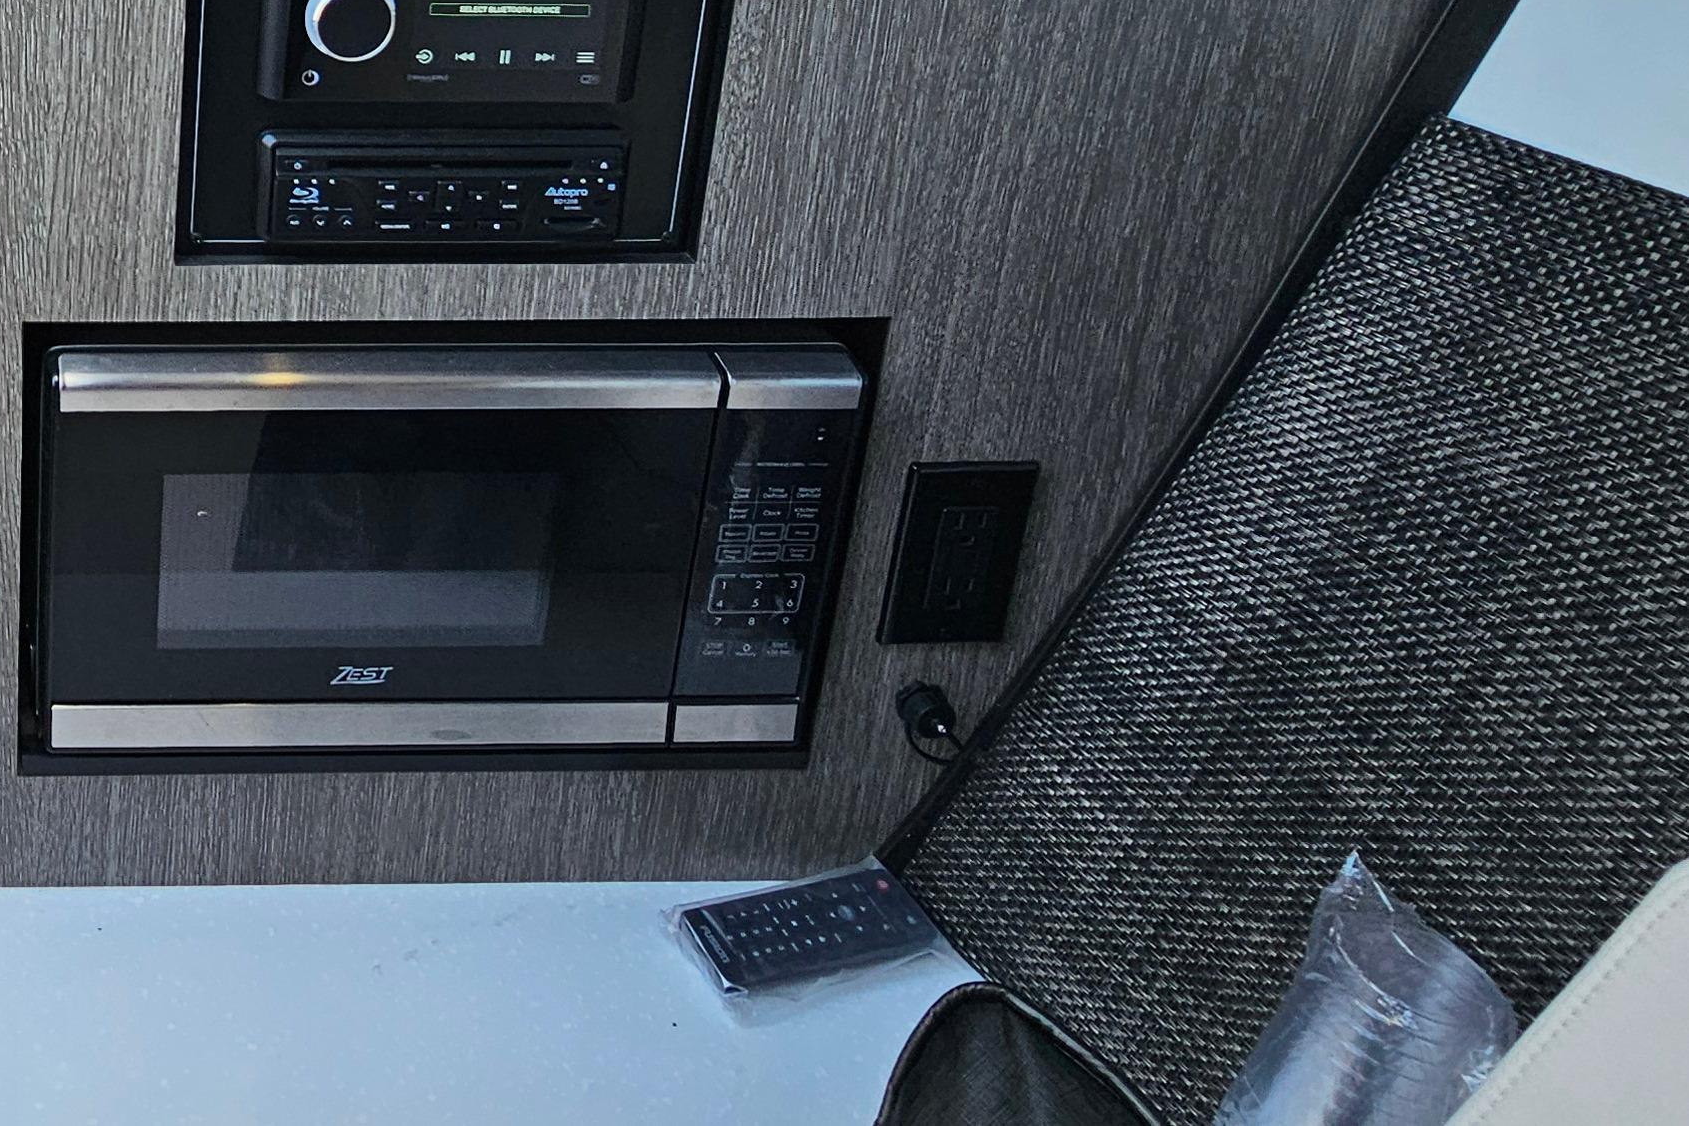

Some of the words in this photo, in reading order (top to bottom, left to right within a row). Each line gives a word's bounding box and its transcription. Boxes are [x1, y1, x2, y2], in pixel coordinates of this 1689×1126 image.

[459, 5, 488, 13] SELECT
[544, 186, 589, 199] Autopro
[721, 581, 728, 590] 1
[754, 580, 763, 590] 2
[789, 580, 798, 589] 3
[716, 600, 724, 608] 4
[751, 598, 759, 608] 5
[786, 599, 794, 607] 6
[714, 617, 722, 626] 7
[747, 617, 756, 626] 8
[782, 617, 790, 625] 9
[330, 666, 394, 685] ZEST
